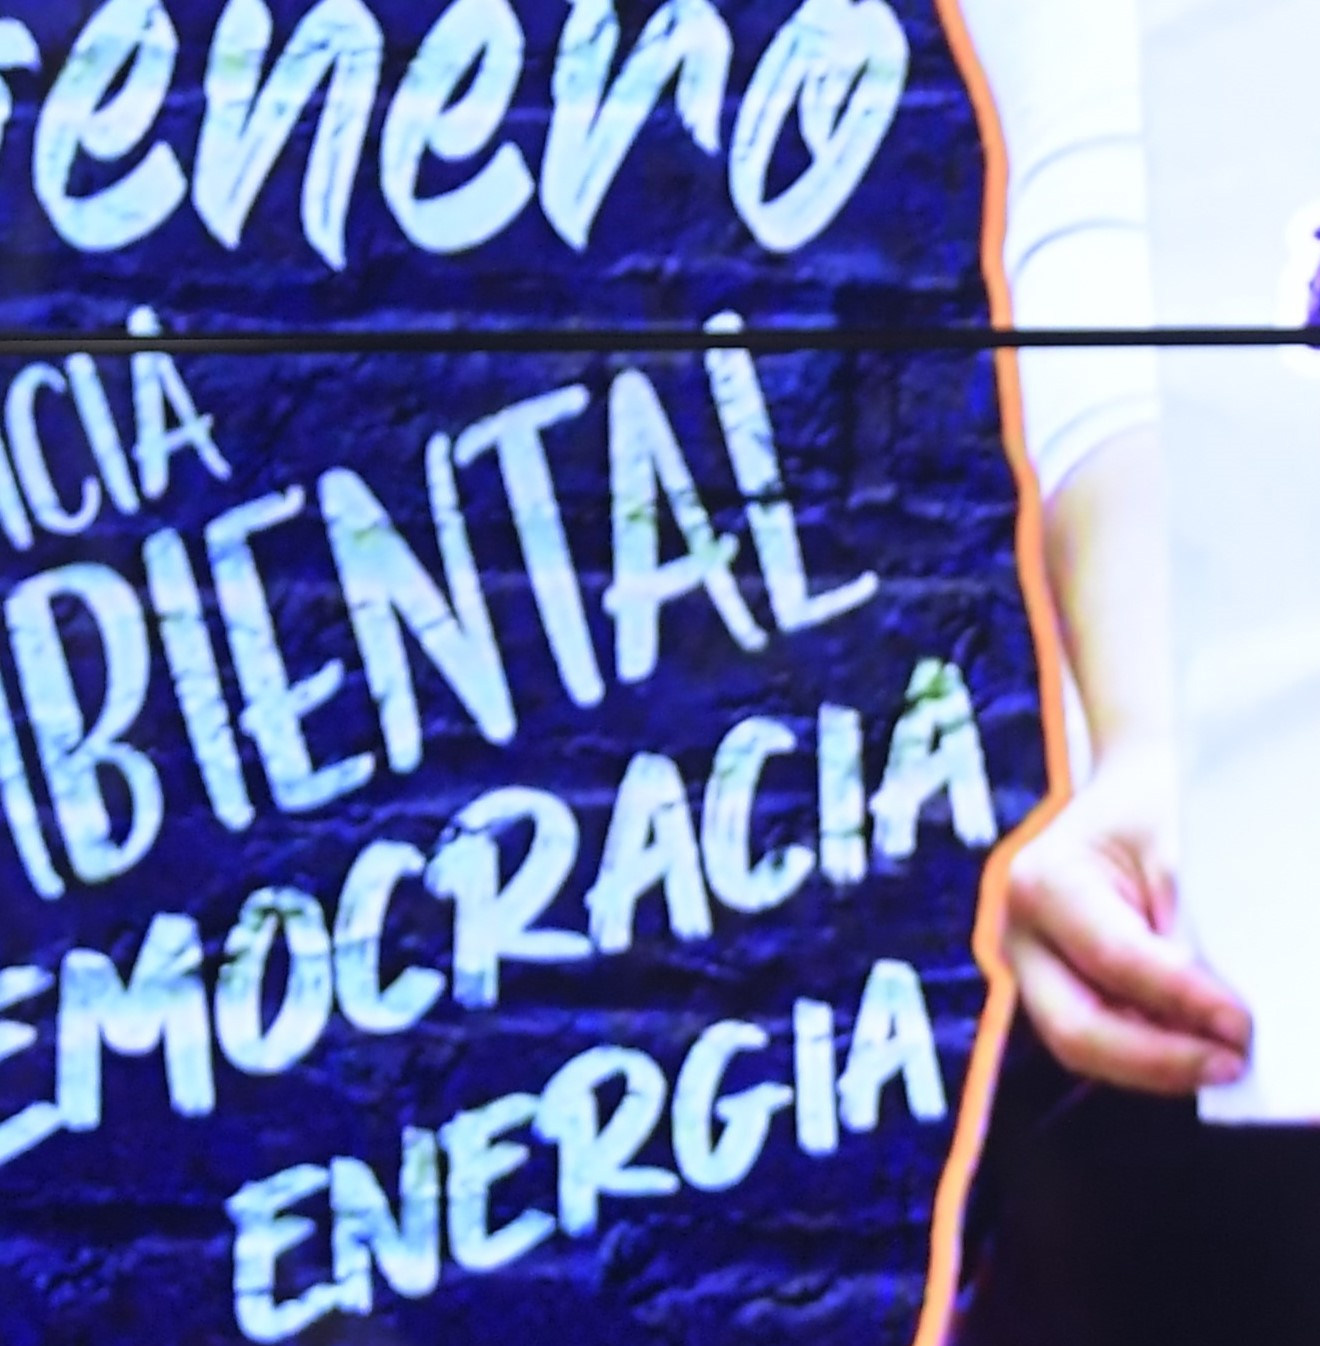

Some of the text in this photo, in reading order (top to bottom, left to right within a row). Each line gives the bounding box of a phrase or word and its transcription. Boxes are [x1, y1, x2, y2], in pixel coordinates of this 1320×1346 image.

[0, 0, 909, 271] enero
[0, 305, 232, 550] CIA
[0, 311, 878, 900] BIENTAL
[226, 960, 947, 1344] ENERGIA
